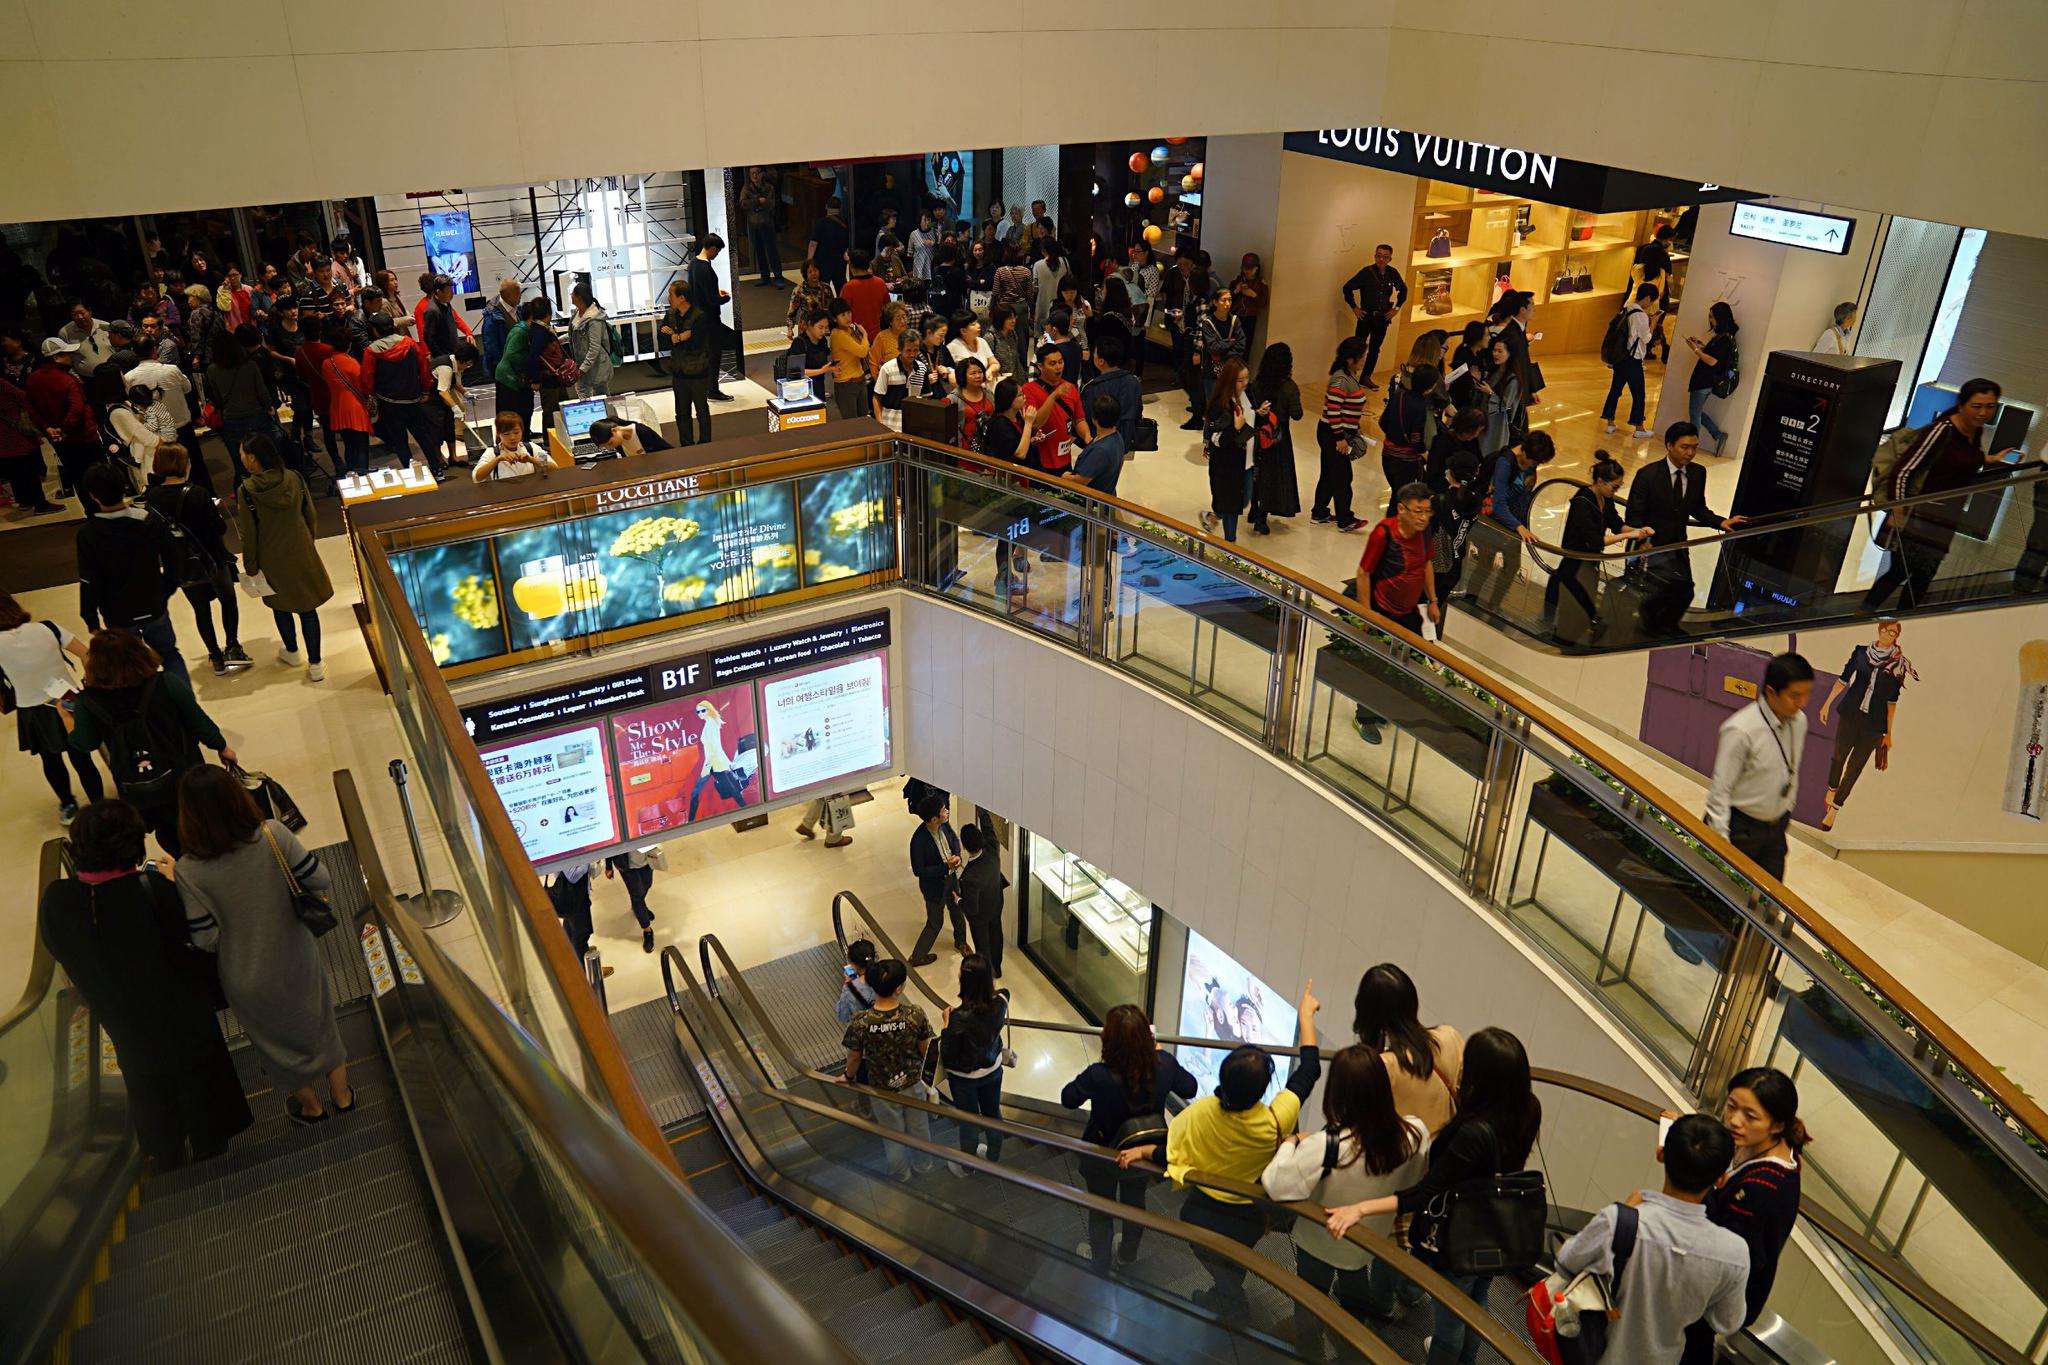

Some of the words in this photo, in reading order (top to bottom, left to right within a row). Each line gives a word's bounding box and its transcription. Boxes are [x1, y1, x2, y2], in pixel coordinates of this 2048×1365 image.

[1319, 127, 1400, 157] LOUIS
[1413, 132, 1557, 189] VUITTON
[1791, 372, 1841, 391] DIRECTORY
[1806, 414, 1821, 433] 2
[715, 653, 740, 665] Fashion
[741, 649, 761, 660] Watch
[769, 641, 792, 653] Luxury
[792, 637, 812, 647] Watch
[818, 629, 843, 641] Jewelry
[851, 620, 884, 633] Electronics
[716, 668, 733, 679] Bags
[733, 660, 765, 673] Collection
[774, 653, 797, 664] Korean
[797, 649, 812, 659] food
[820, 641, 850, 653] Chocolate
[858, 633, 882, 644] Tobacco
[661, 663, 700, 691] B1F
[488, 705, 521, 719] Souvenir
[529, 693, 570, 709] Sunglasses
[577, 685, 606, 698] Jewelry
[612, 681, 625, 690] Gift
[625, 676, 643, 687] Desk
[490, 718, 518, 732] Korean
[518, 710, 555, 726] Cosmetics
[594, 692, 627, 707] Members
[627, 688, 645, 700] Desk
[777, 695, 794, 708] 너의
[628, 717, 684, 743] Show
[651, 729, 699, 754] Style
[629, 741, 647, 752] Me
[632, 750, 652, 760] The
